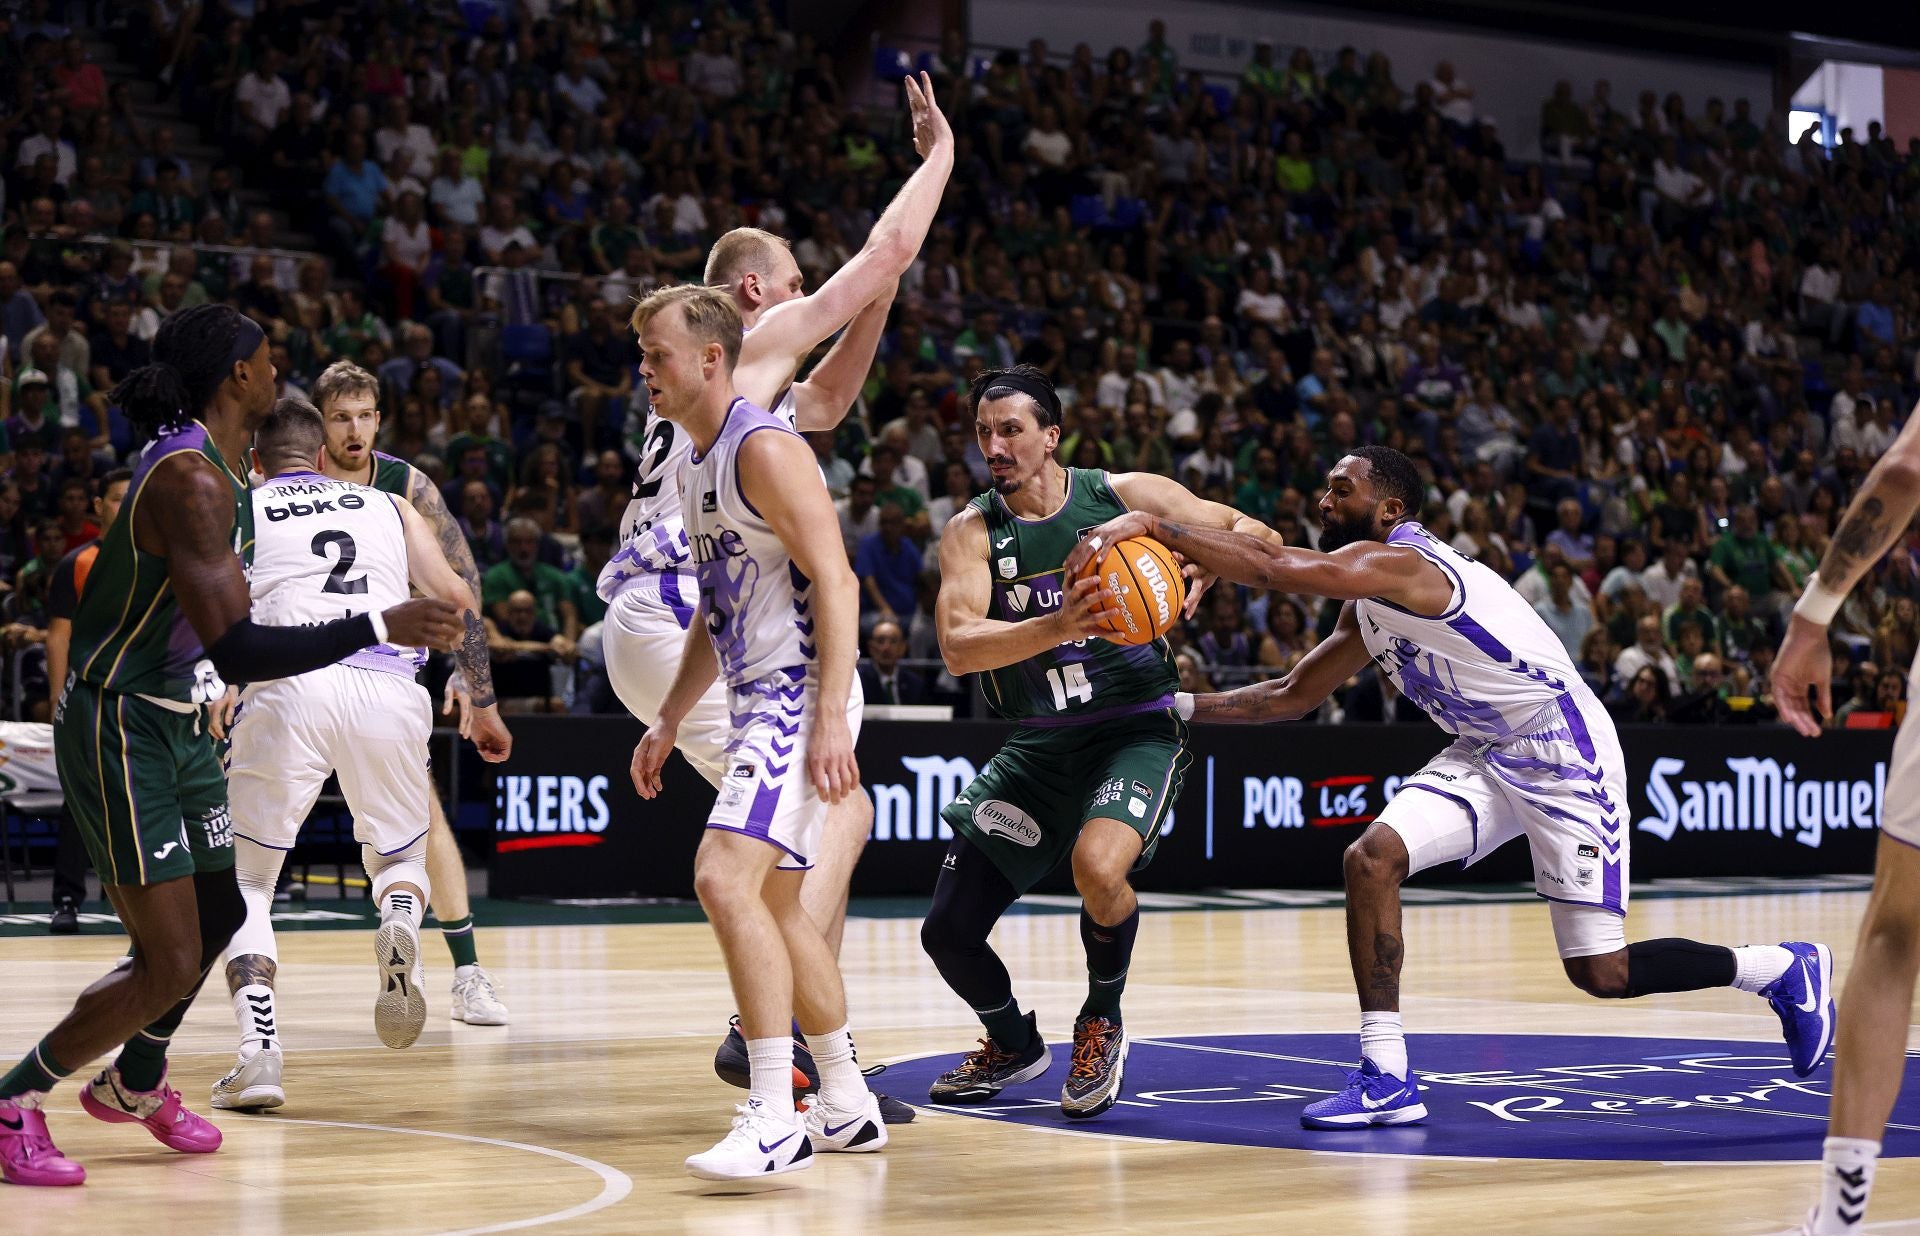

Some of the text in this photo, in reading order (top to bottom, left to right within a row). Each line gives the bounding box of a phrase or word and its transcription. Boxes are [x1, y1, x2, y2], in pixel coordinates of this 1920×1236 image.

[264, 499, 338, 523] bbk
[311, 529, 369, 595] 2
[1136, 552, 1171, 627] Wilson
[1045, 663, 1094, 711] 14
[975, 800, 1039, 842] famadesa
[1242, 775, 1305, 829] POR
